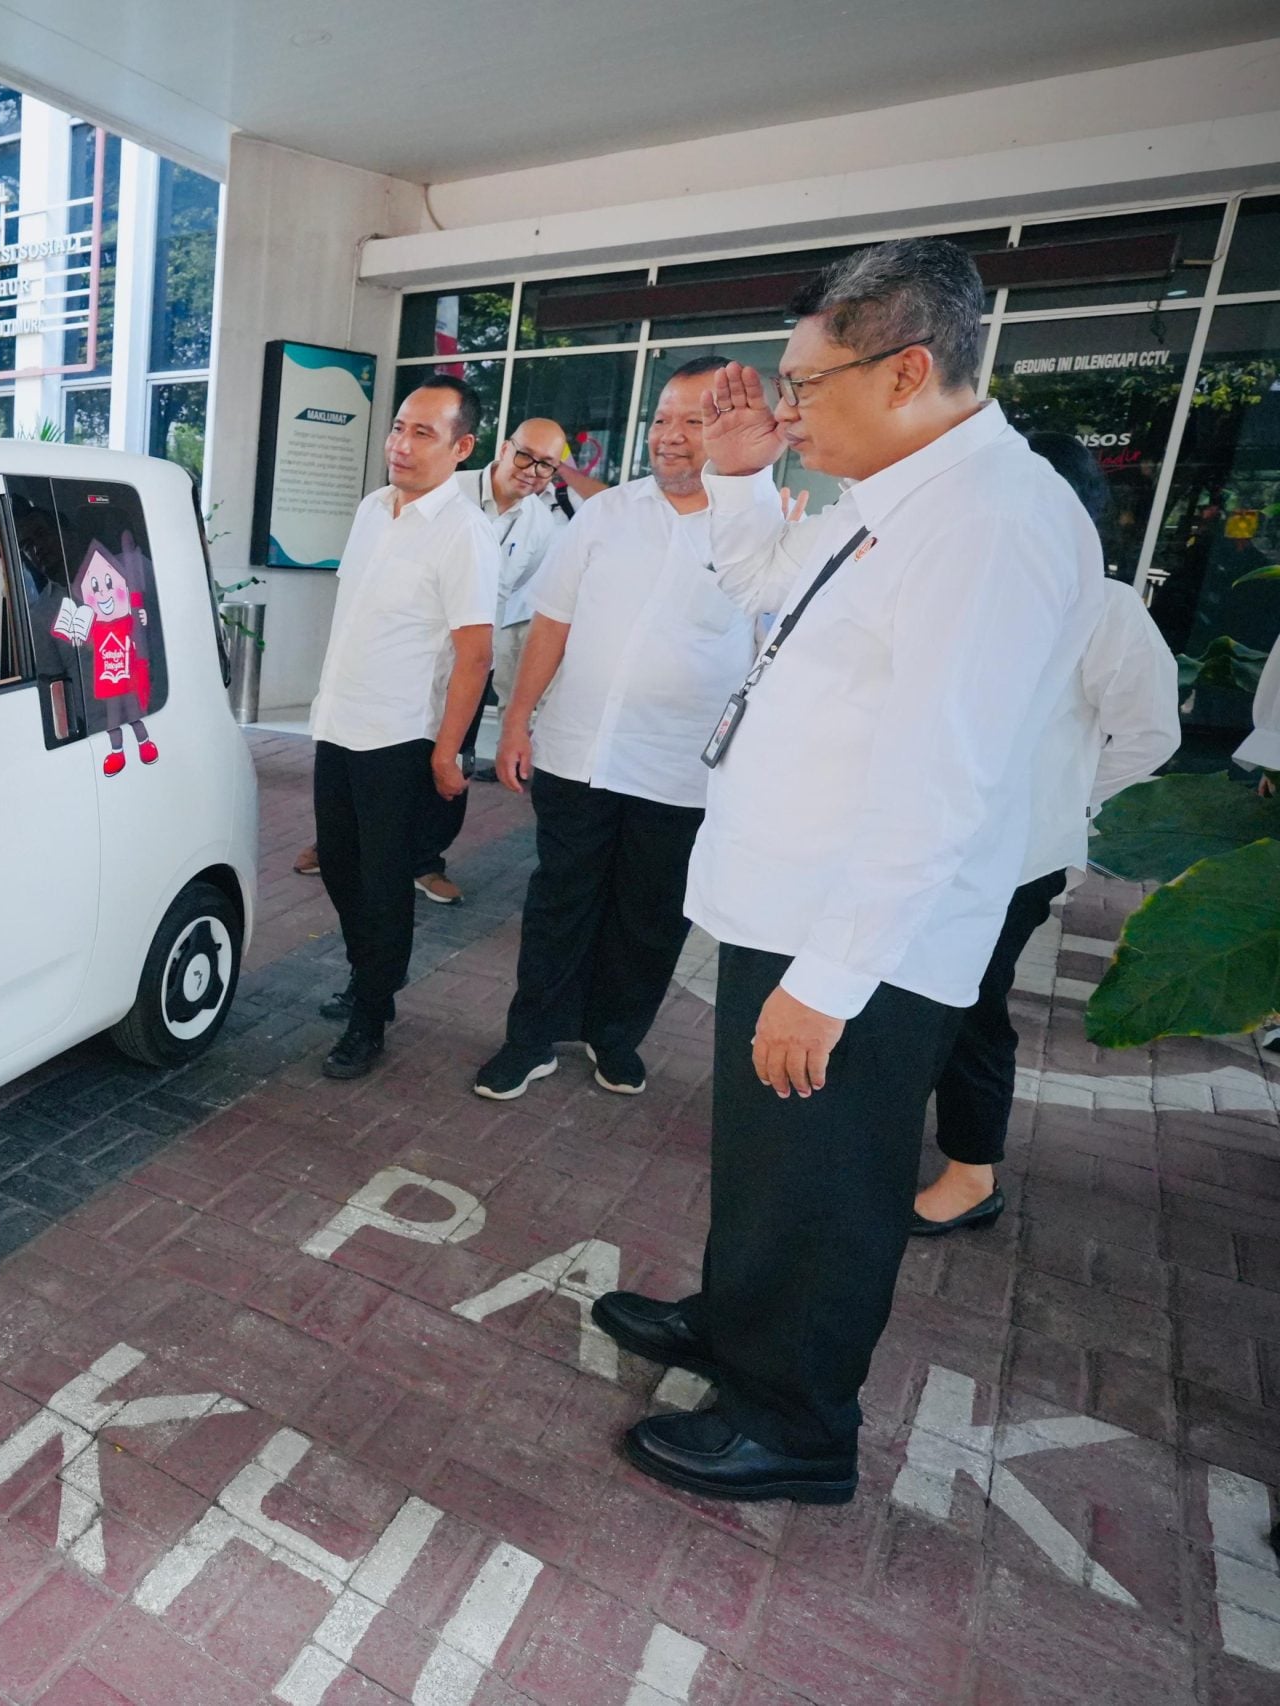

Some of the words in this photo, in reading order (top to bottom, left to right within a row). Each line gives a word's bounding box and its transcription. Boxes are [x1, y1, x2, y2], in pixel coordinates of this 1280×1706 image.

[1013, 357, 1056, 375] GEDUNG
[1057, 356, 1073, 372] INI
[1074, 352, 1138, 371] DILENGKAPI
[1139, 350, 1170, 366] CCTV
[306, 409, 348, 424] MAKLUMAT
[1074, 432, 1132, 447] NSOS
